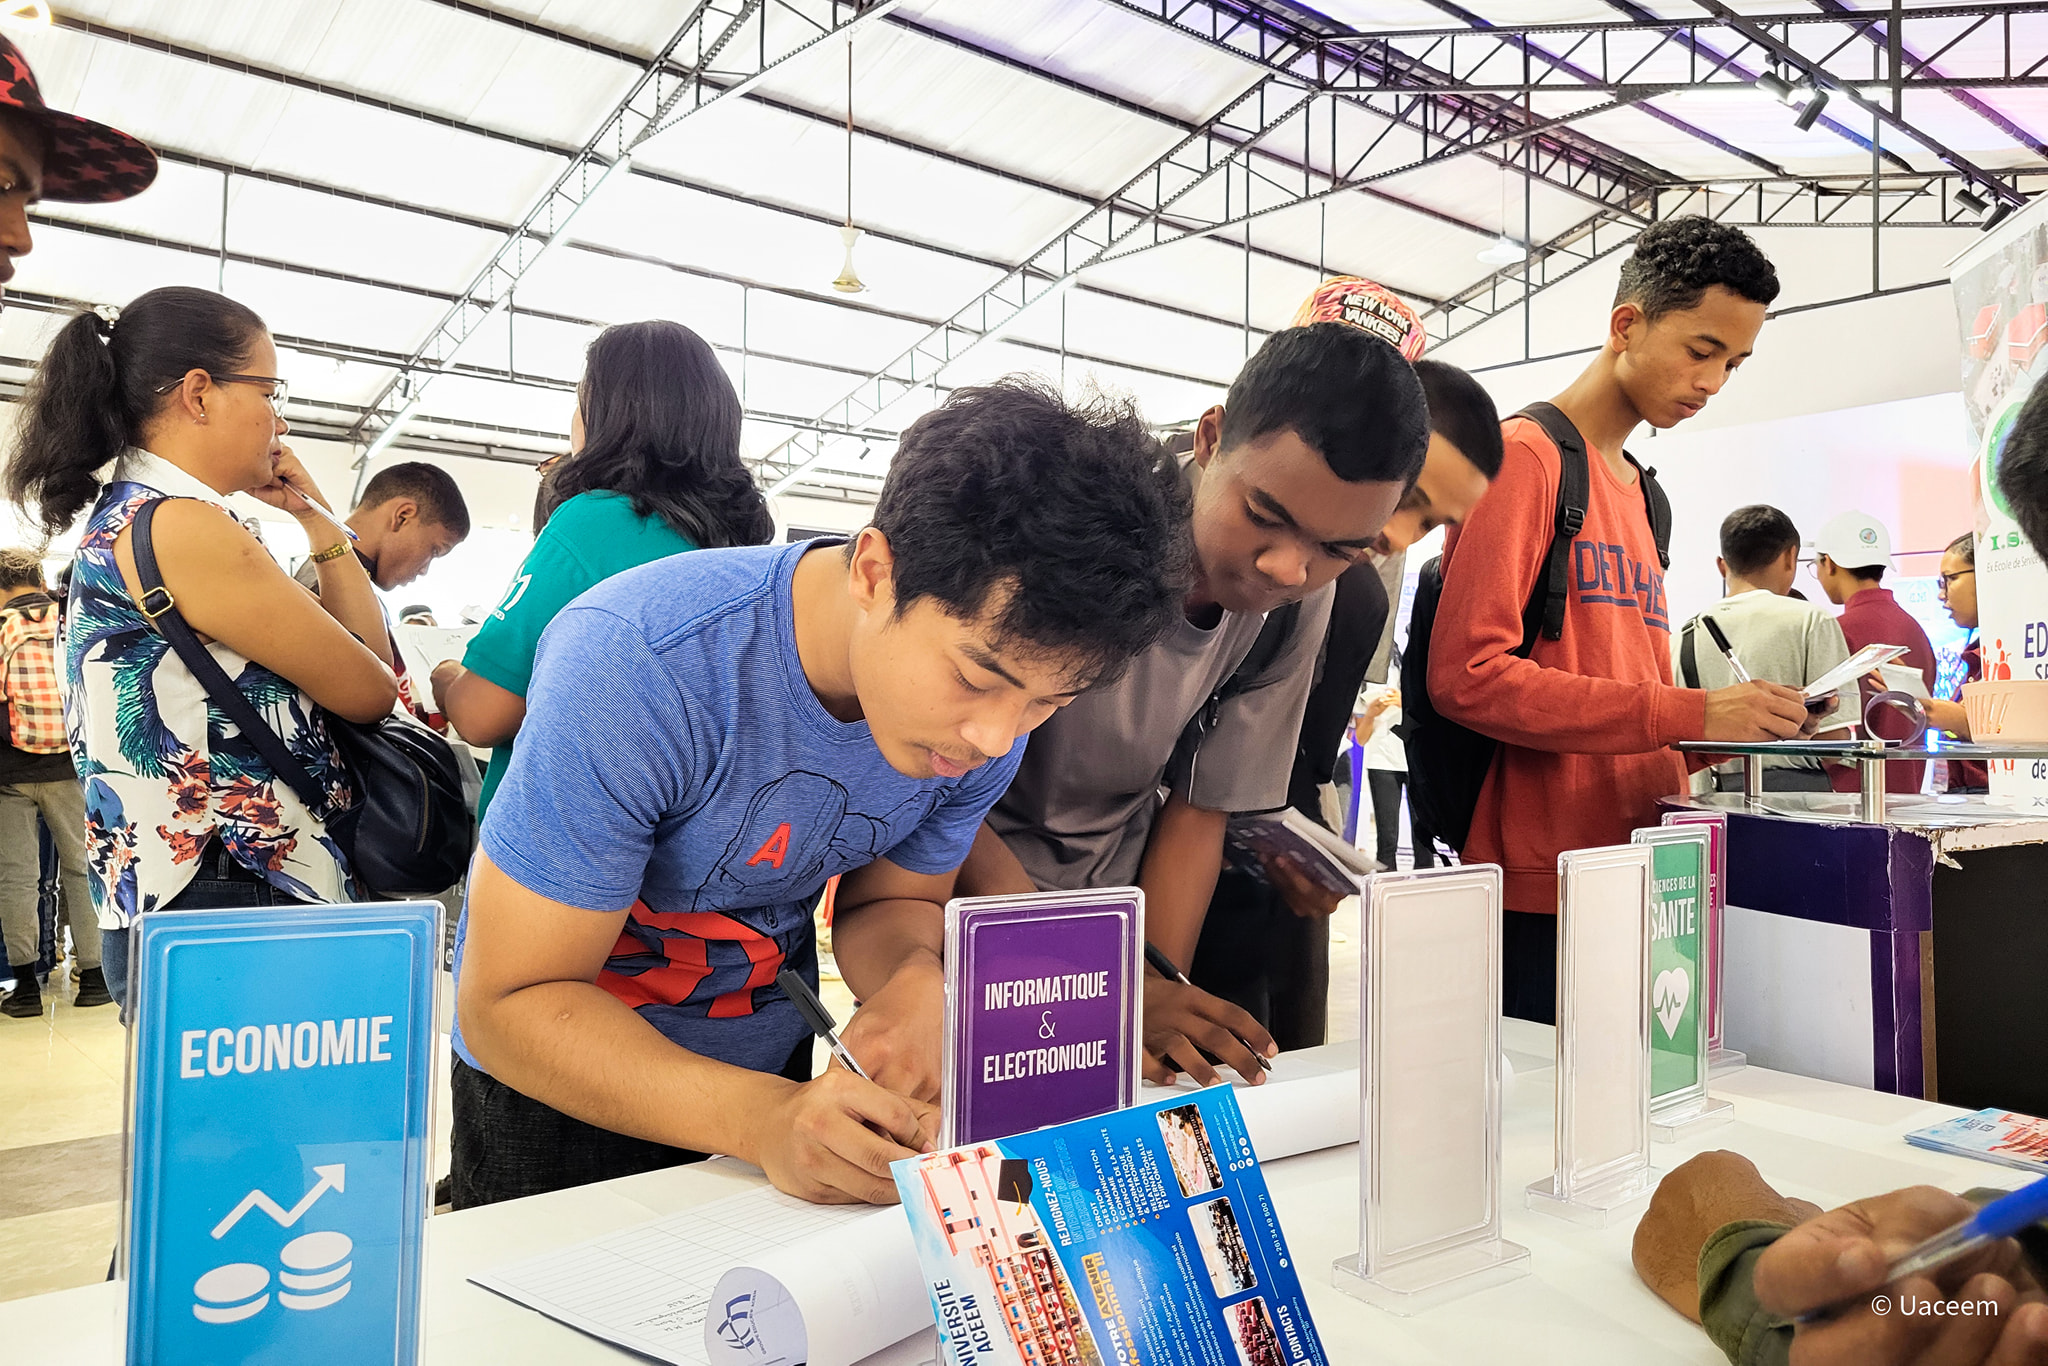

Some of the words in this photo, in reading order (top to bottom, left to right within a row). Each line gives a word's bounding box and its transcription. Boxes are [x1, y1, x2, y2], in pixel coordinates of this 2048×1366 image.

[1344, 294, 1379, 311] NEW
[1379, 301, 1411, 333] YORK
[1344, 307, 1401, 343] YANKEES
[1994, 558, 2011, 572] Ecole
[745, 822, 791, 869] A
[1652, 877, 1677, 894] CIENCES
[1679, 876, 1687, 890] DE
[1688, 875, 1695, 889] LA
[1651, 897, 1695, 942] SANTE
[985, 971, 1108, 1011] INFORMATIQUE
[1038, 1011, 1056, 1039] &
[180, 1015, 393, 1079] ECONOMIE
[983, 1040, 1107, 1083] ELECTRONIQUE
[1100, 1127, 1113, 1153] SANTE
[1109, 1154, 1117, 1164] LA
[1089, 1148, 1119, 1222] COMMUNICATION
[1113, 1165, 1121, 1176] DE
[1118, 1153, 1144, 1216] INFORMATIQUE
[1122, 1145, 1147, 1205] ELECTRONIQUE
[1135, 1137, 1164, 1210] INTERNATIONALES
[1138, 1167, 1158, 1212] RELATIONS
[1145, 1148, 1166, 1197] DIPLOMATIE
[1033, 1156, 1072, 1246] REJOIGNEZ-NOUS!
[1089, 1200, 1103, 1227] DROIT
[1094, 1187, 1111, 1225] GESTION
[1107, 1175, 1127, 1220] ECONOMIE
[1117, 1177, 1135, 1218] SCIENCES
[1143, 1206, 1150, 1214] &
[1161, 1198, 1170, 1208] ET
[1258, 1193, 1265, 1201] 71
[1260, 1201, 1271, 1217] 500
[1269, 1228, 1278, 1238] 34
[1273, 1238, 1283, 1256] +261
[1083, 1257, 1110, 1316] AVENIR
[959, 1293, 993, 1355] ACEEM
[1098, 1268, 1141, 1366] fessionnels
[1276, 1304, 1304, 1359] CONTACTS
